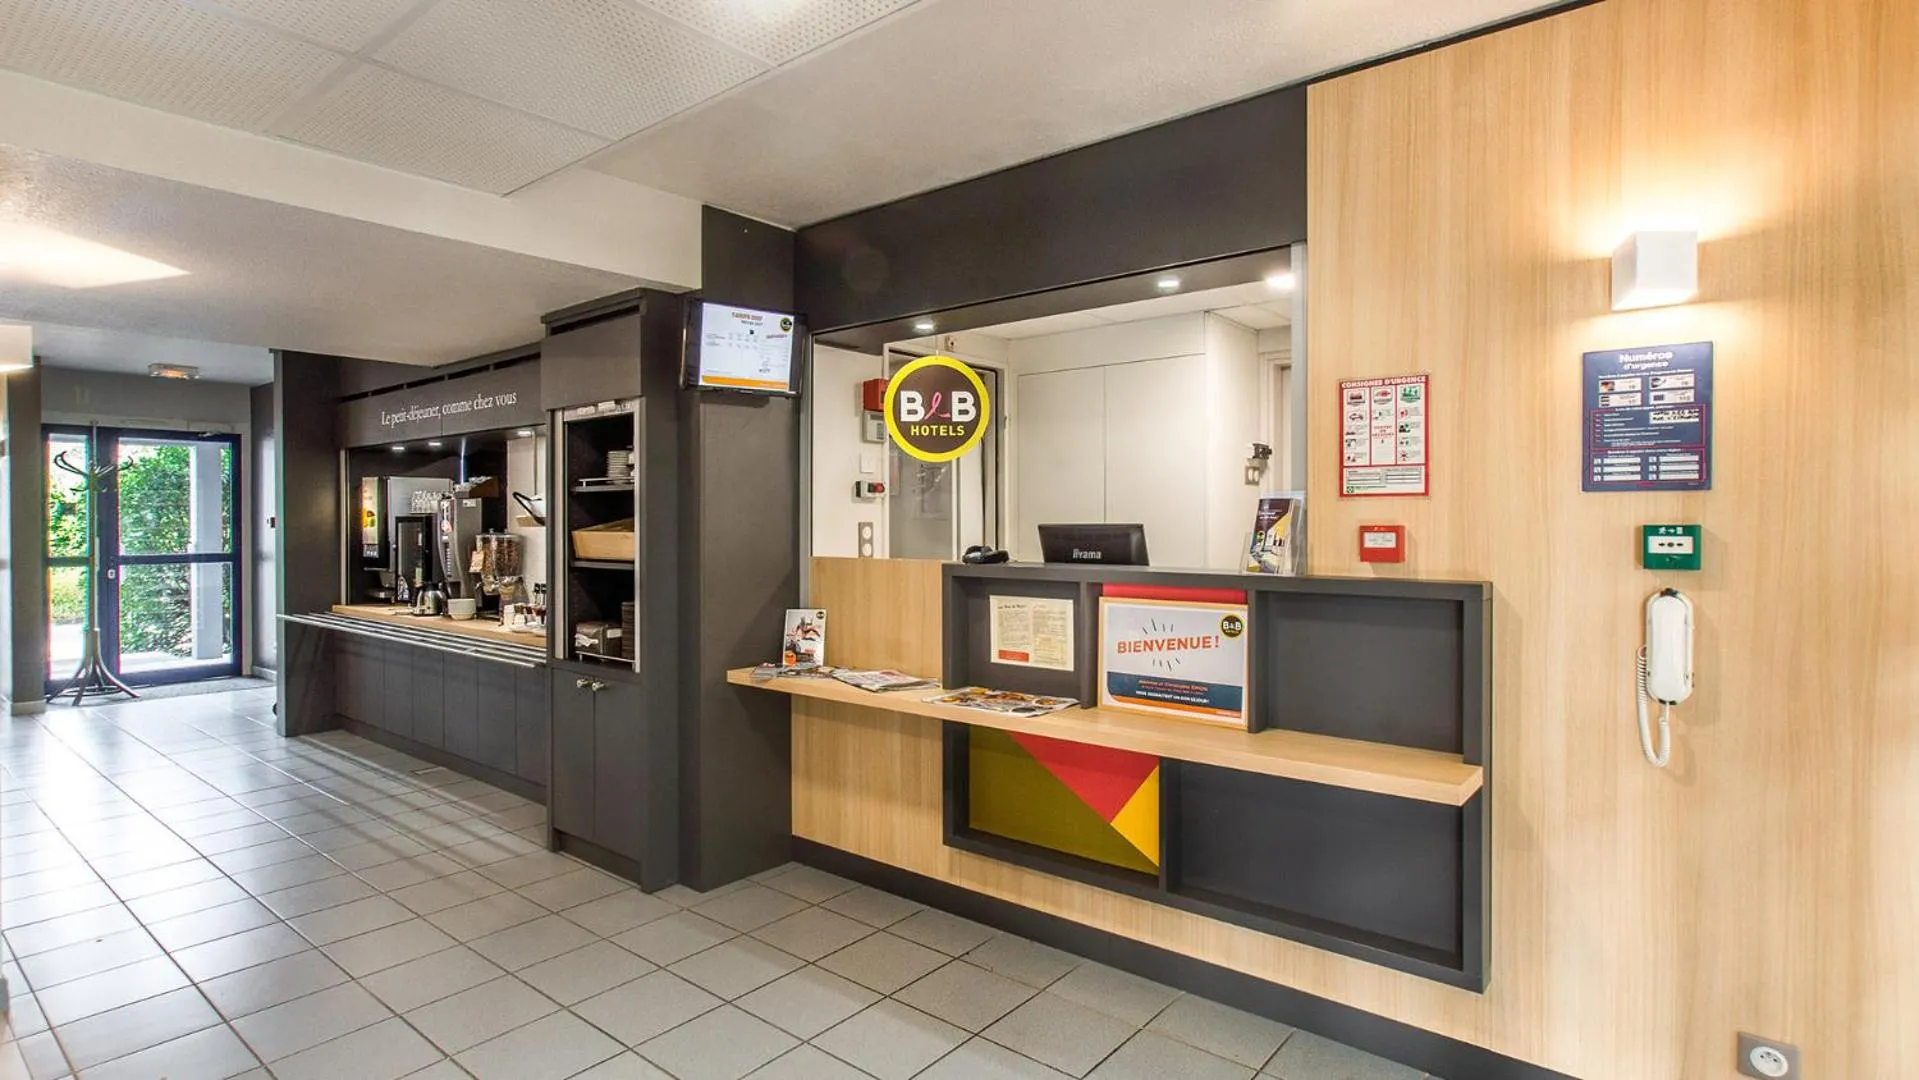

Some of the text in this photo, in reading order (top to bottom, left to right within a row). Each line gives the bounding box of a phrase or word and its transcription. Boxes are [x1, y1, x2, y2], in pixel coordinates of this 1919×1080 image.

[1619, 351, 1673, 363] Numéros
[1342, 376, 1425, 388] CONSIGNES D'URGENCE
[381, 392, 517, 428] Le petit-déjeuner, comme chez vous
[911, 425, 965, 436] HOTELS
